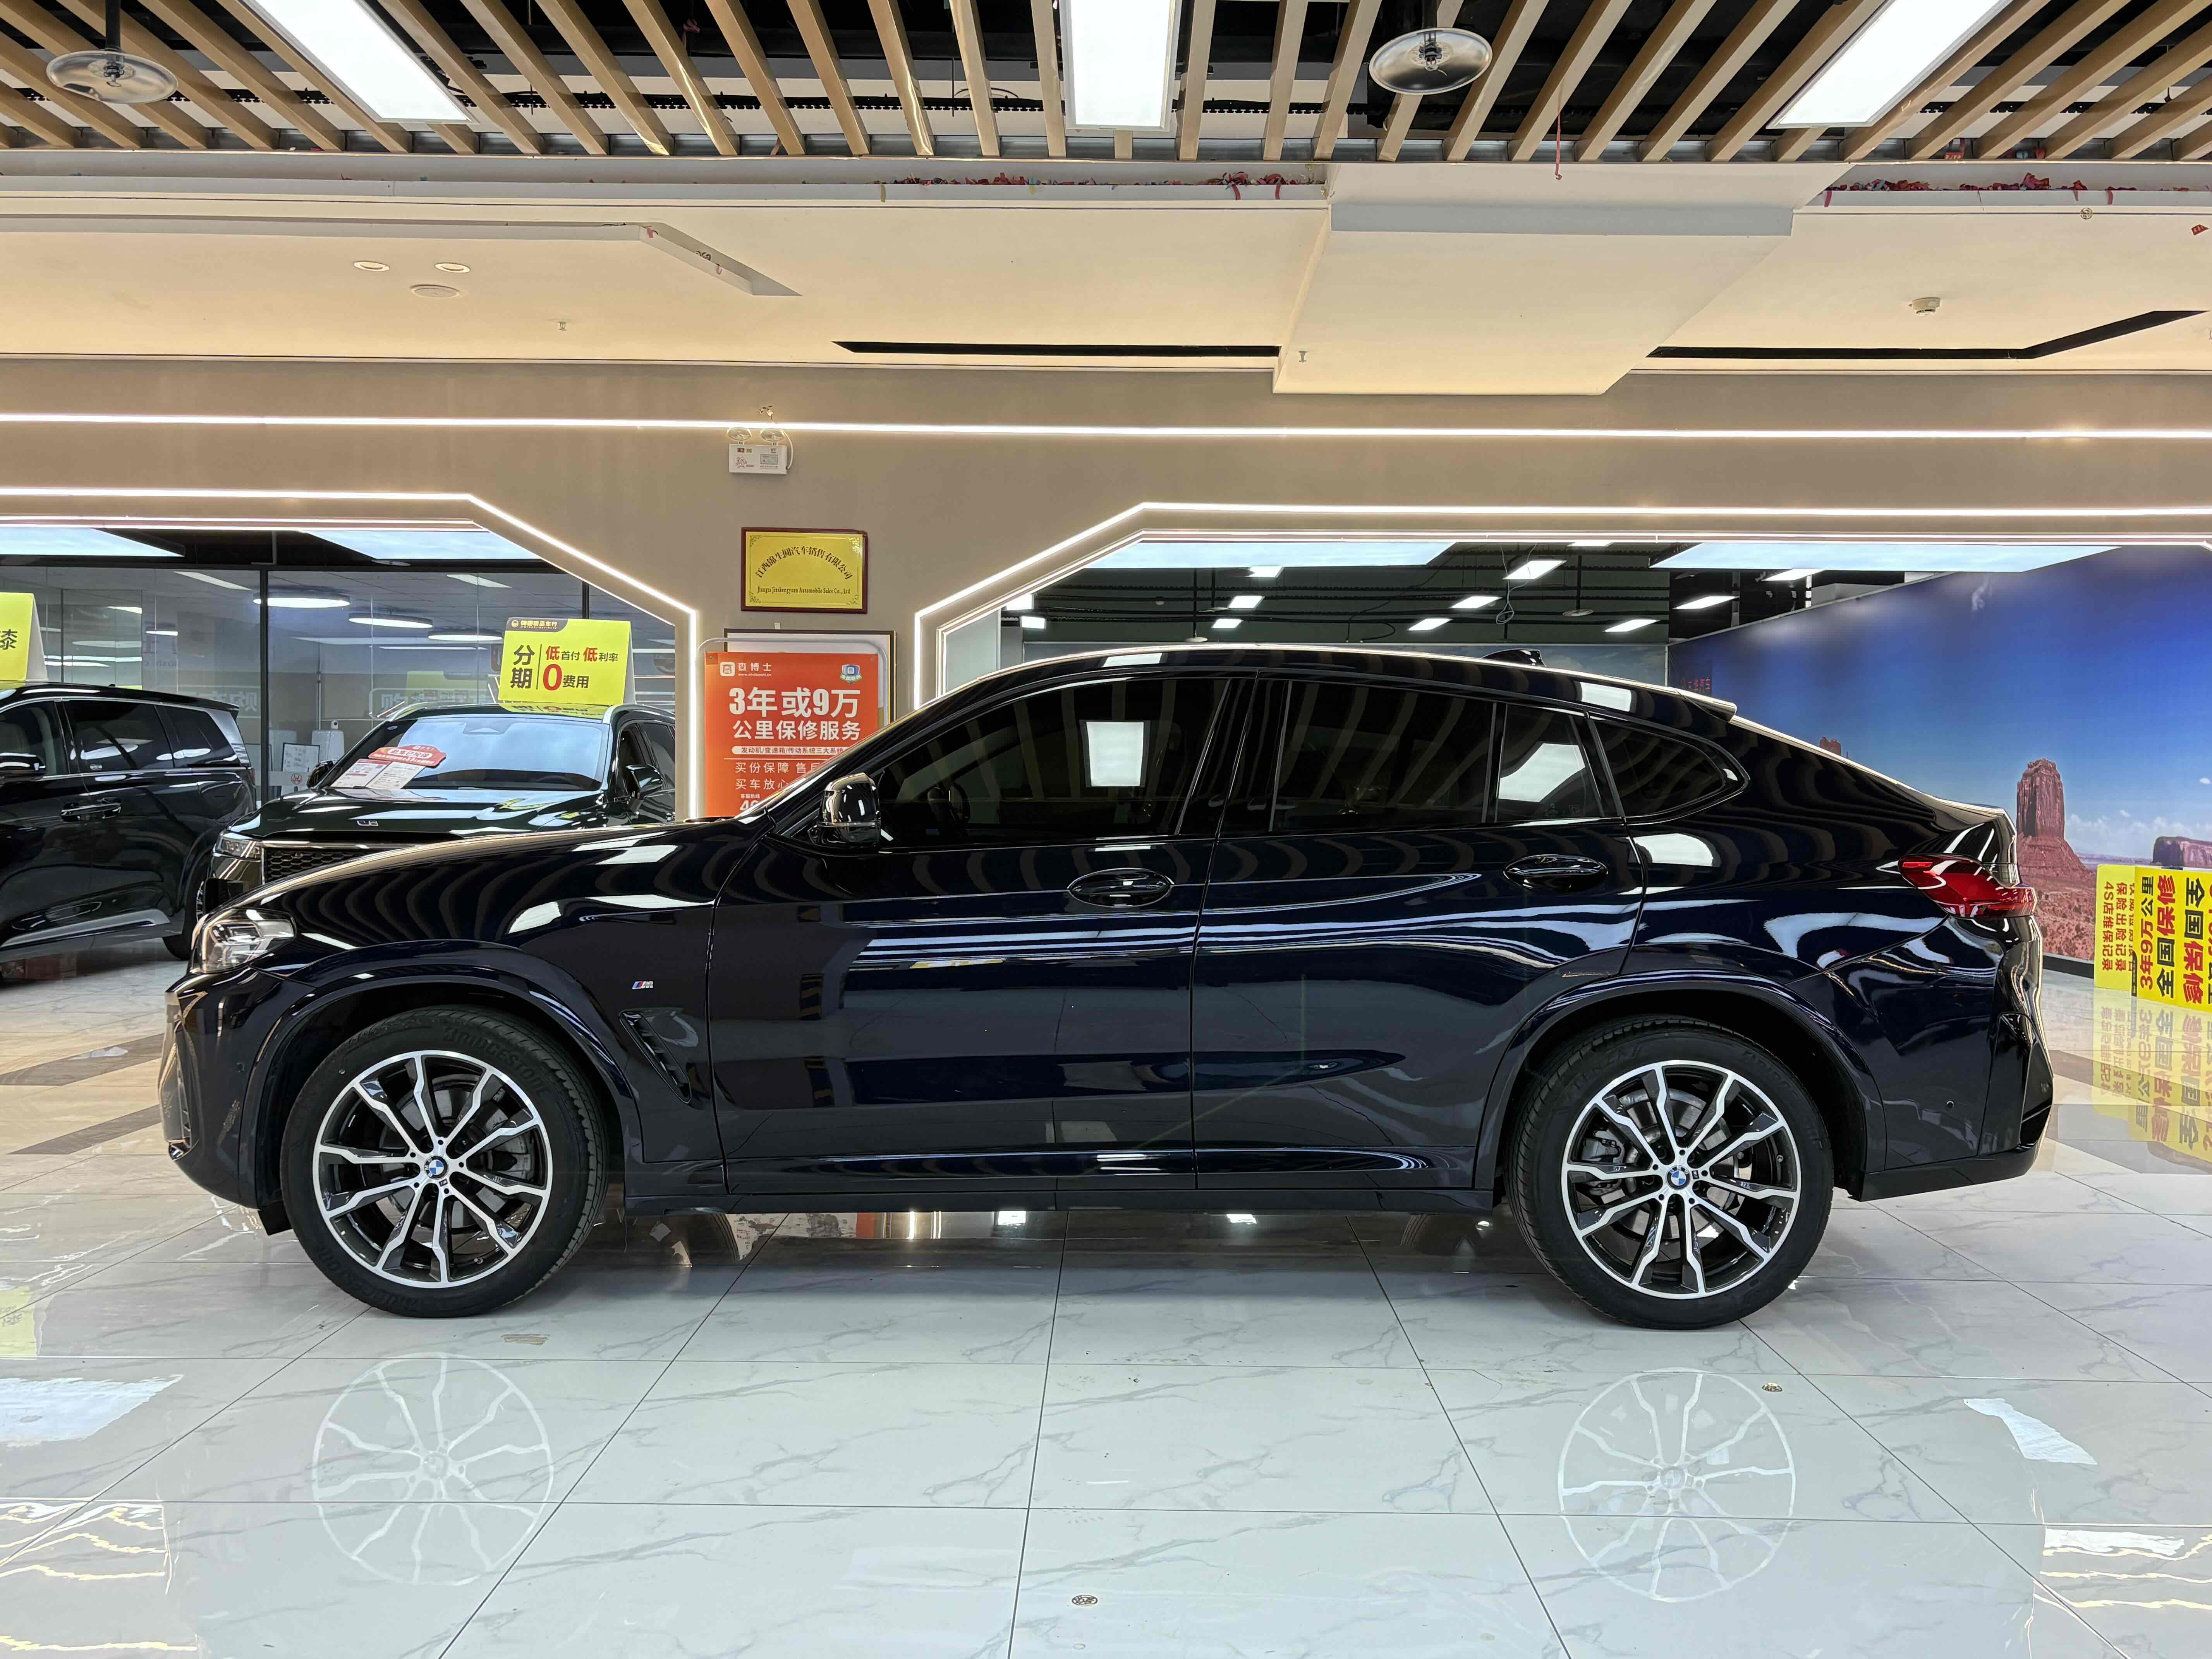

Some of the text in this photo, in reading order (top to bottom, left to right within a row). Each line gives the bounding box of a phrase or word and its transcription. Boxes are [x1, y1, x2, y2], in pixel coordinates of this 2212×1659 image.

[729, 687, 861, 718] 3年或9万
[738, 663, 772, 671] 查博士
[732, 720, 861, 741] 公里保修服务
[735, 762, 790, 774] 买份保障
[2102, 881, 2114, 971] 4S店维保记录
[2115, 882, 2128, 972] 保险出险记录
[2140, 876, 2154, 991] 3年9万公里
[2157, 875, 2176, 999] 全国保修
[2183, 878, 2205, 1004] 全国保修
